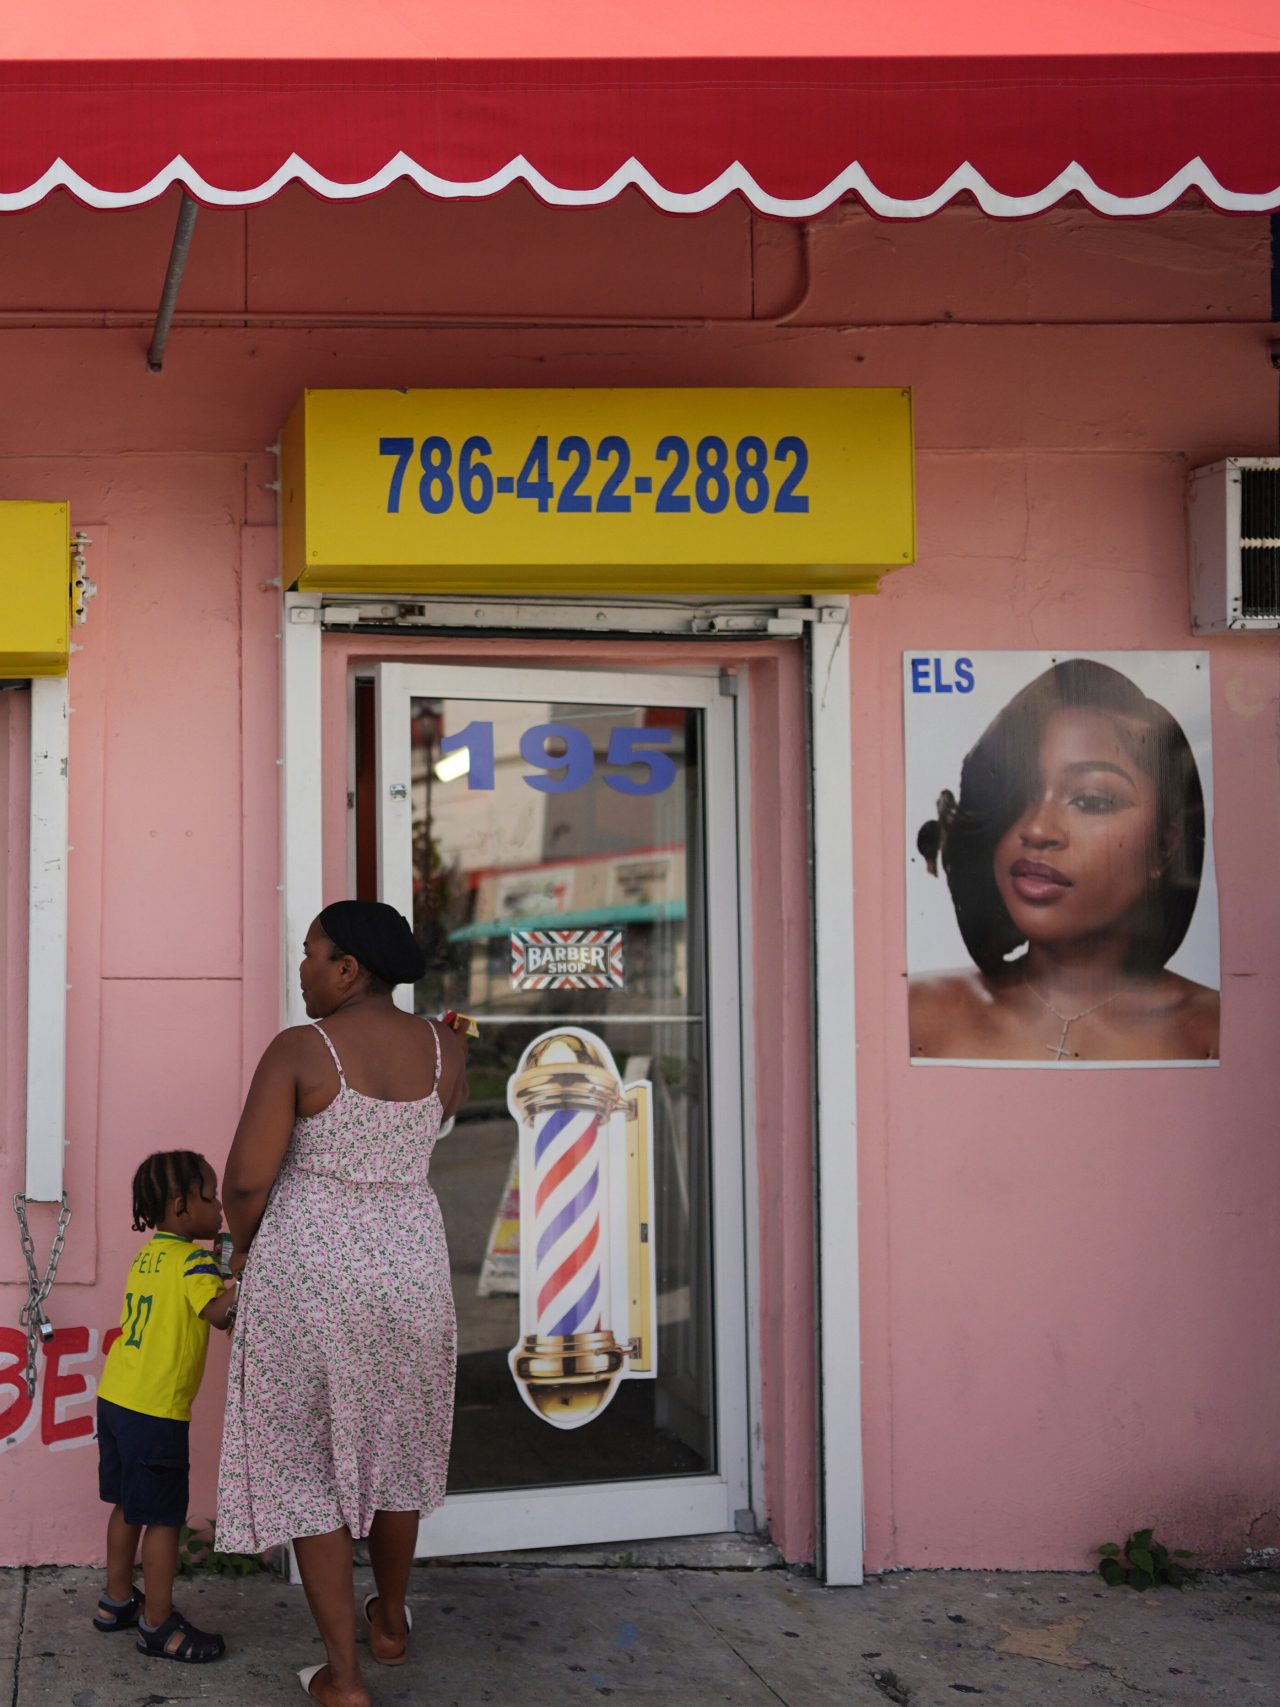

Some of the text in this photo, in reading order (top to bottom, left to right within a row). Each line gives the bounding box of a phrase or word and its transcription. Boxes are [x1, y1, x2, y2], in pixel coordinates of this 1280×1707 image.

[379, 436, 810, 514] 786-422-2882
[911, 657, 976, 695] ELS
[440, 721, 677, 796] 195
[527, 946, 607, 973] BARBER
[547, 962, 586, 974] SHOP
[130, 1251, 166, 1274] PELE
[122, 1292, 154, 1350] 10
